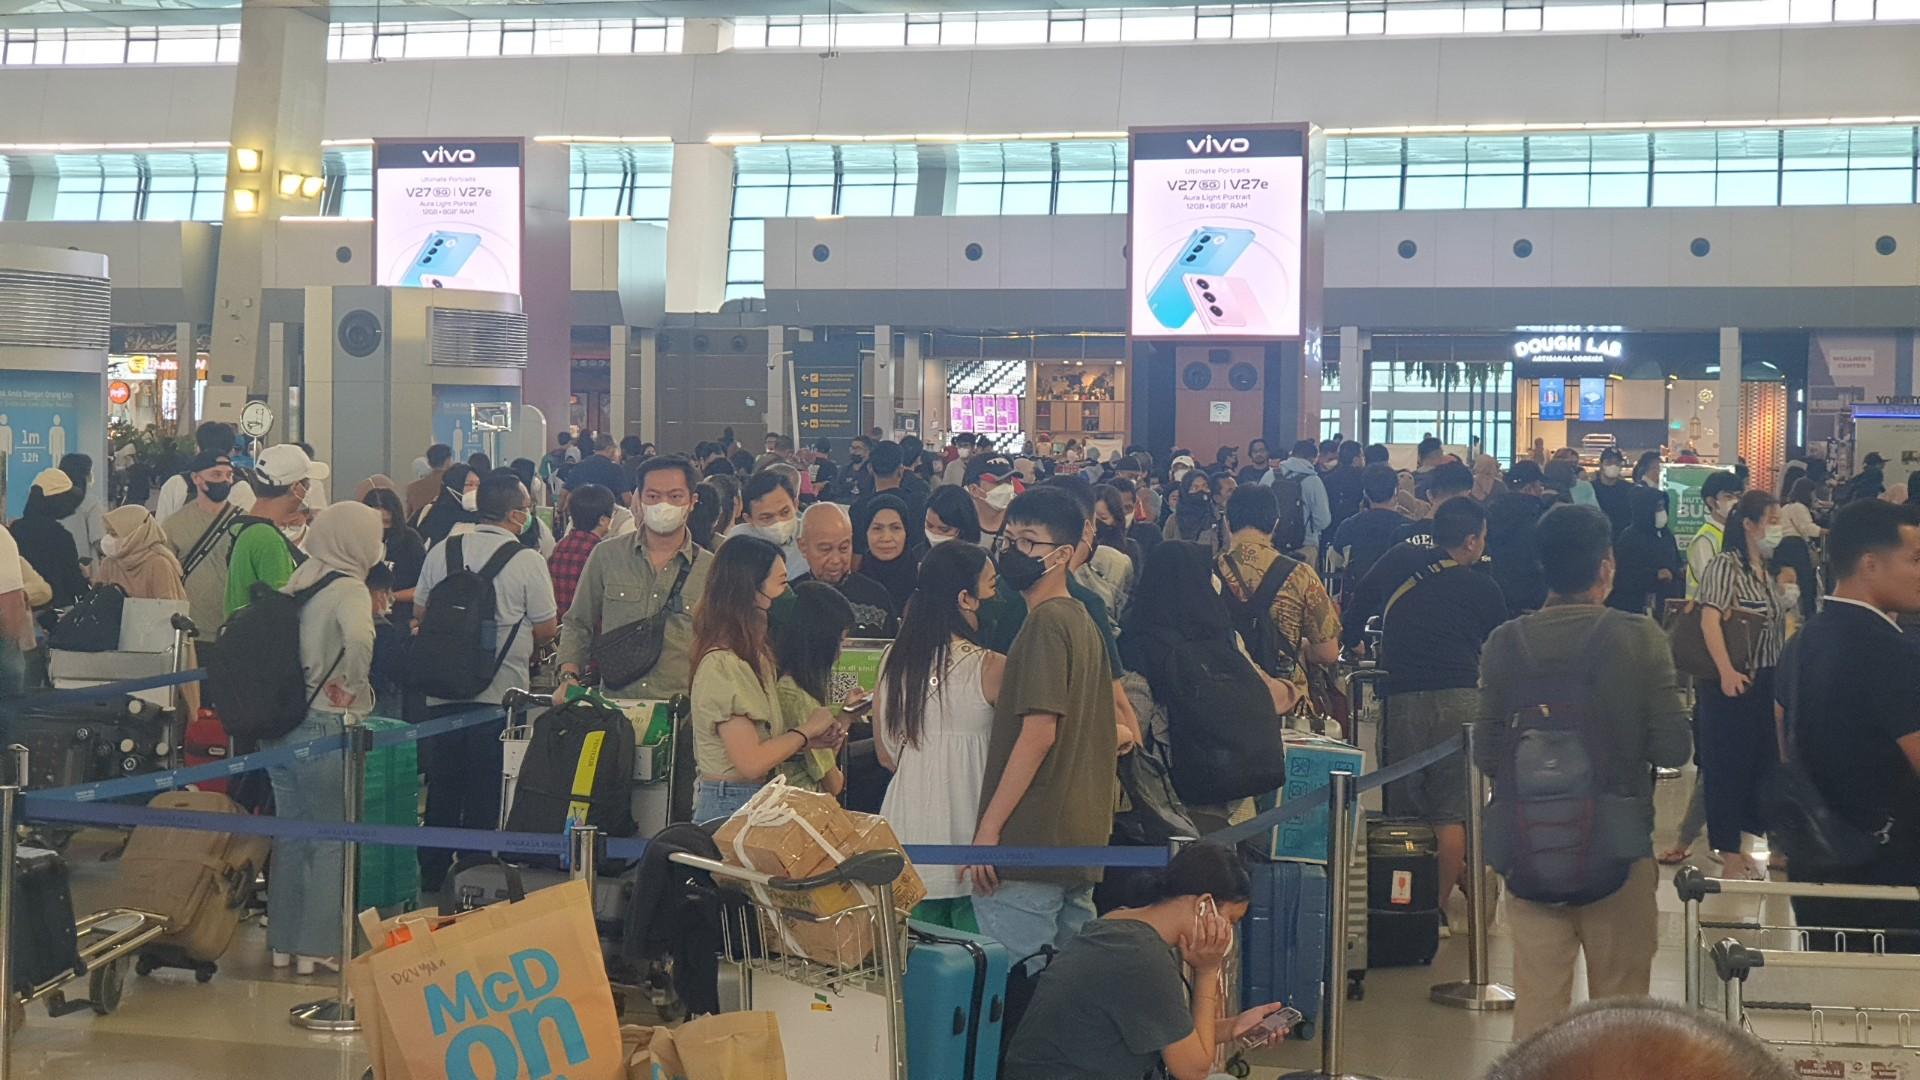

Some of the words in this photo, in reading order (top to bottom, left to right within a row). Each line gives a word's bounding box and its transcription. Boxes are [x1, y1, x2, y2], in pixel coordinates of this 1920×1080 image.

[1186, 134, 1250, 153] vivo
[421, 145, 476, 163] vivo
[406, 187, 432, 197] V27
[458, 187, 492, 197] V27e
[1167, 180, 1197, 191] V27
[1229, 179, 1269, 190] V27e
[1202, 194, 1221, 202] Light
[1514, 335, 1582, 357] DOUGH
[1585, 336, 1622, 357] LAB
[22, 429, 40, 445] 1m
[424, 948, 560, 1037] McD
[445, 996, 591, 1080] on
